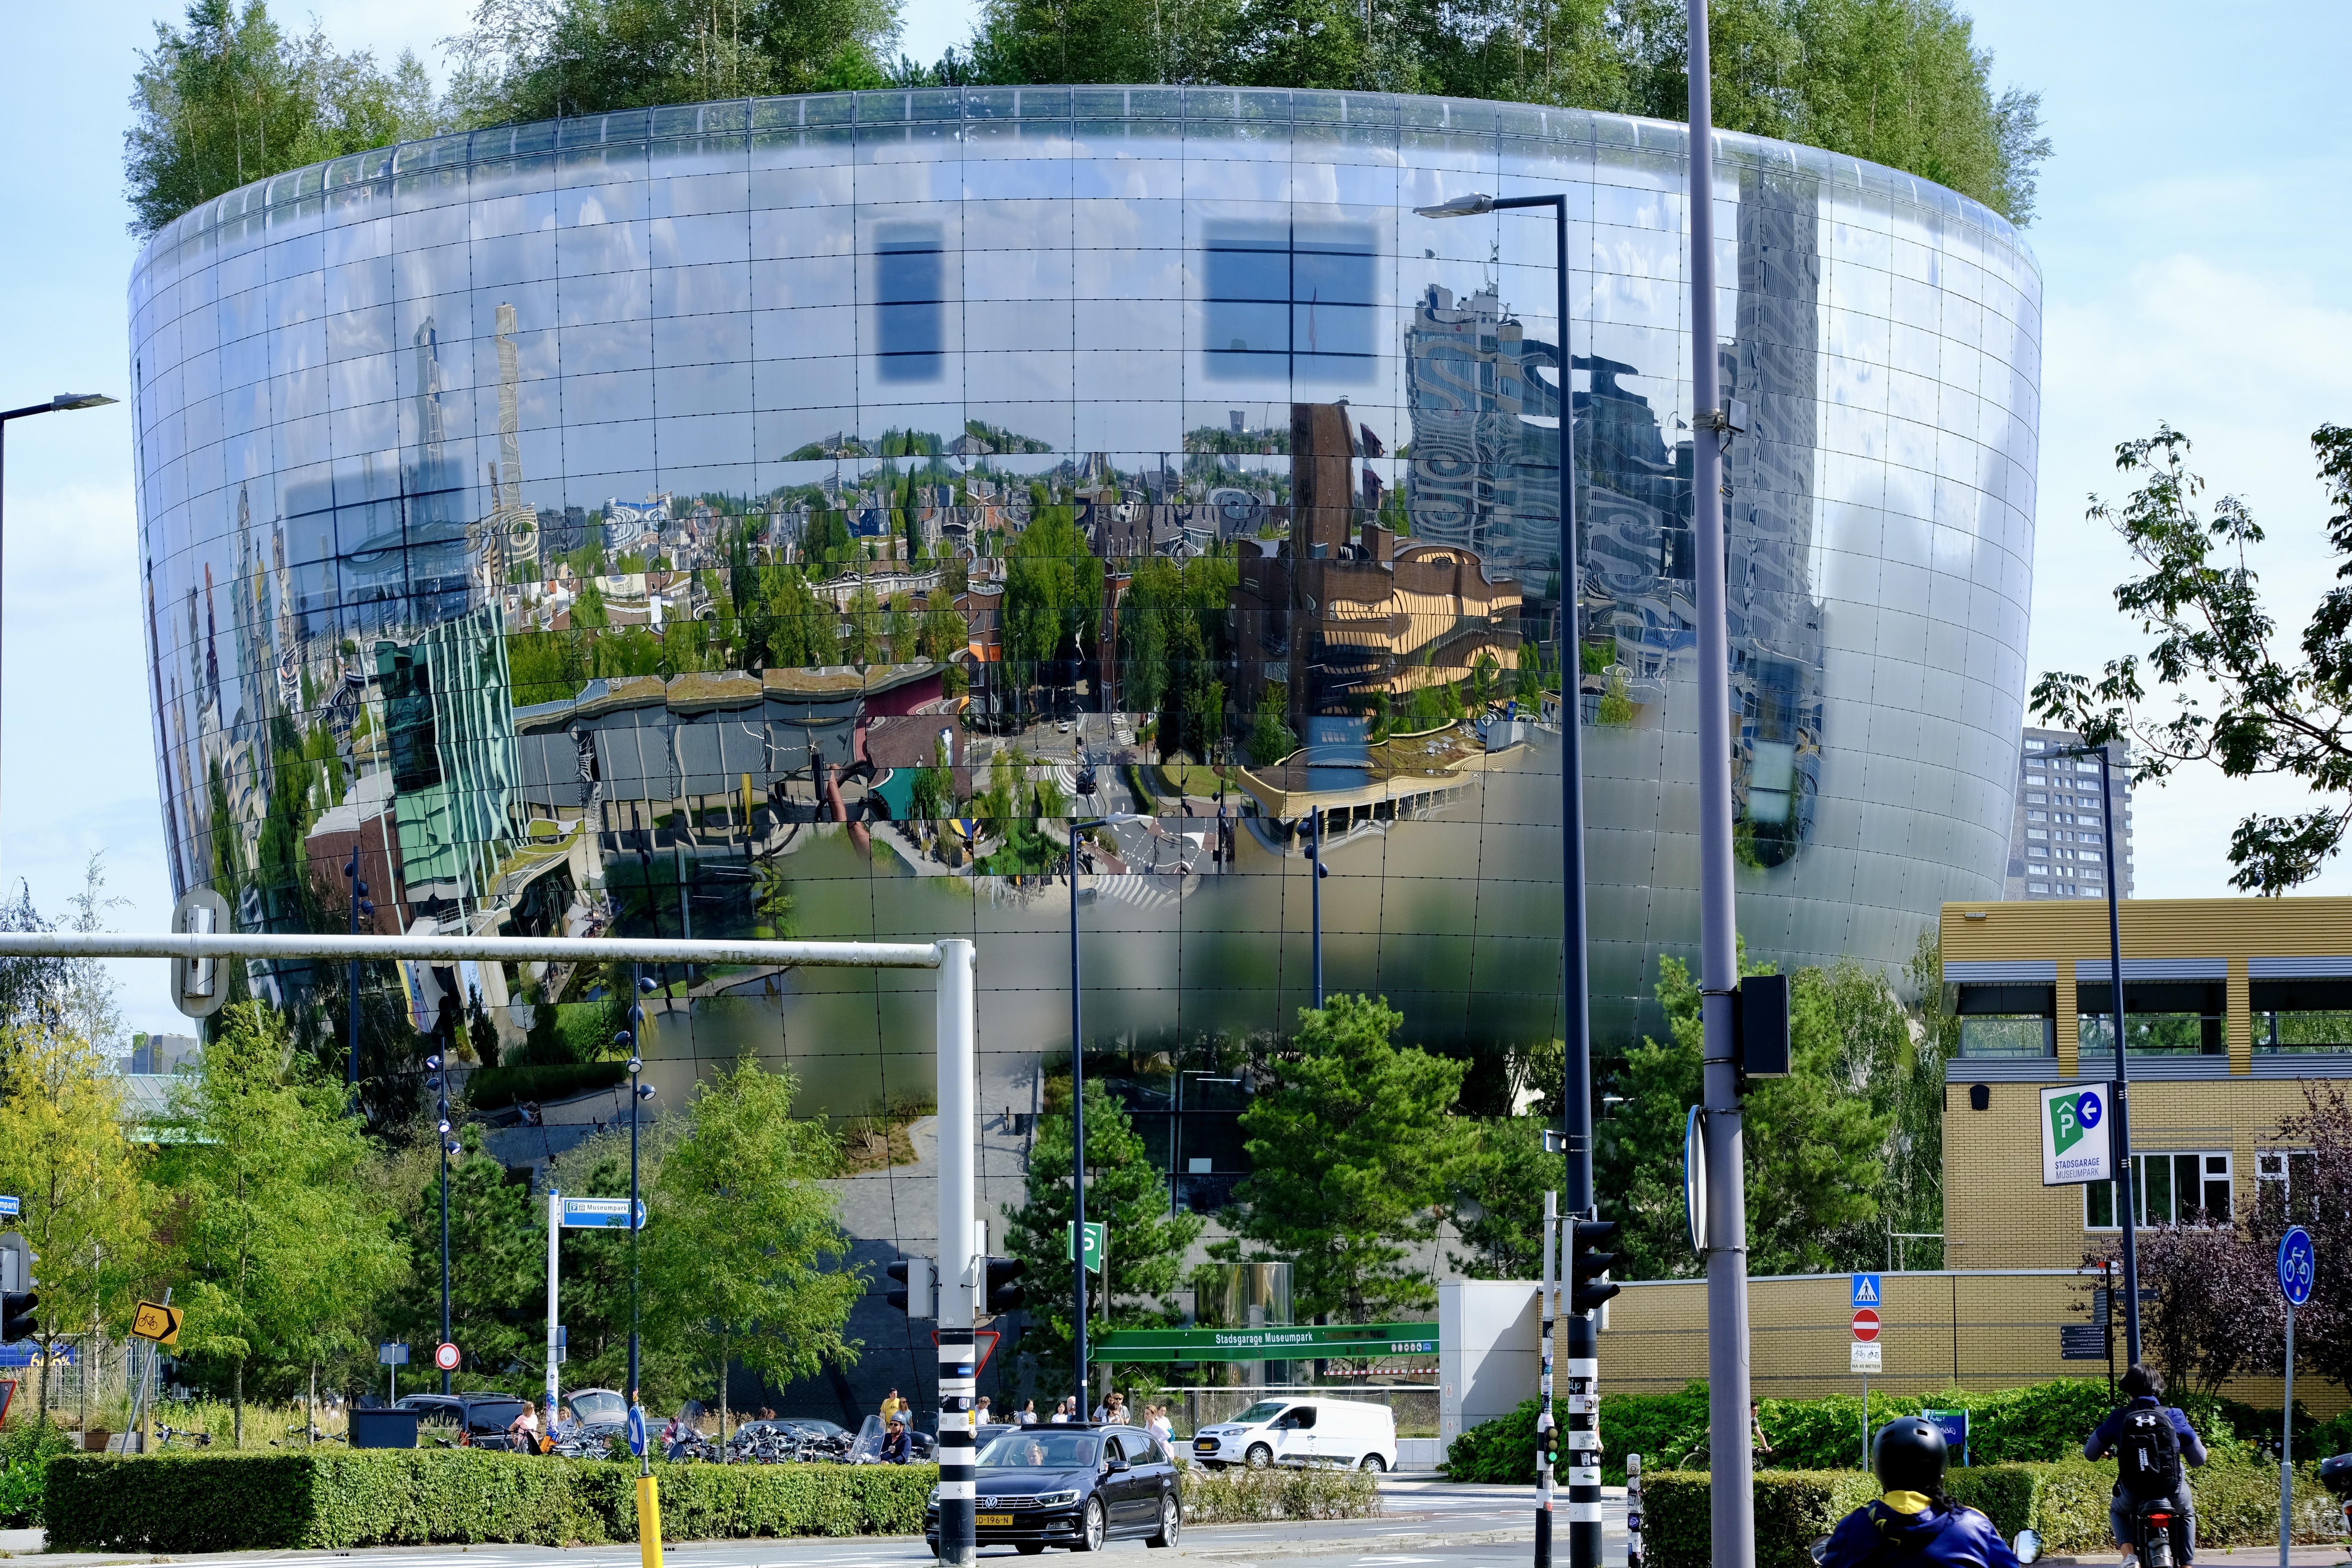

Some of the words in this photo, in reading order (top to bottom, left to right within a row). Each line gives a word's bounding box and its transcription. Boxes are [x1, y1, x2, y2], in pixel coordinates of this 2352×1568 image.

[2055, 1158, 2100, 1169] STADSGARAGE
[2056, 1168, 2099, 1179] MUSEUMPARK
[1216, 1334, 1263, 1346] Stadsgarage
[1265, 1331, 1313, 1344] Museumpark
